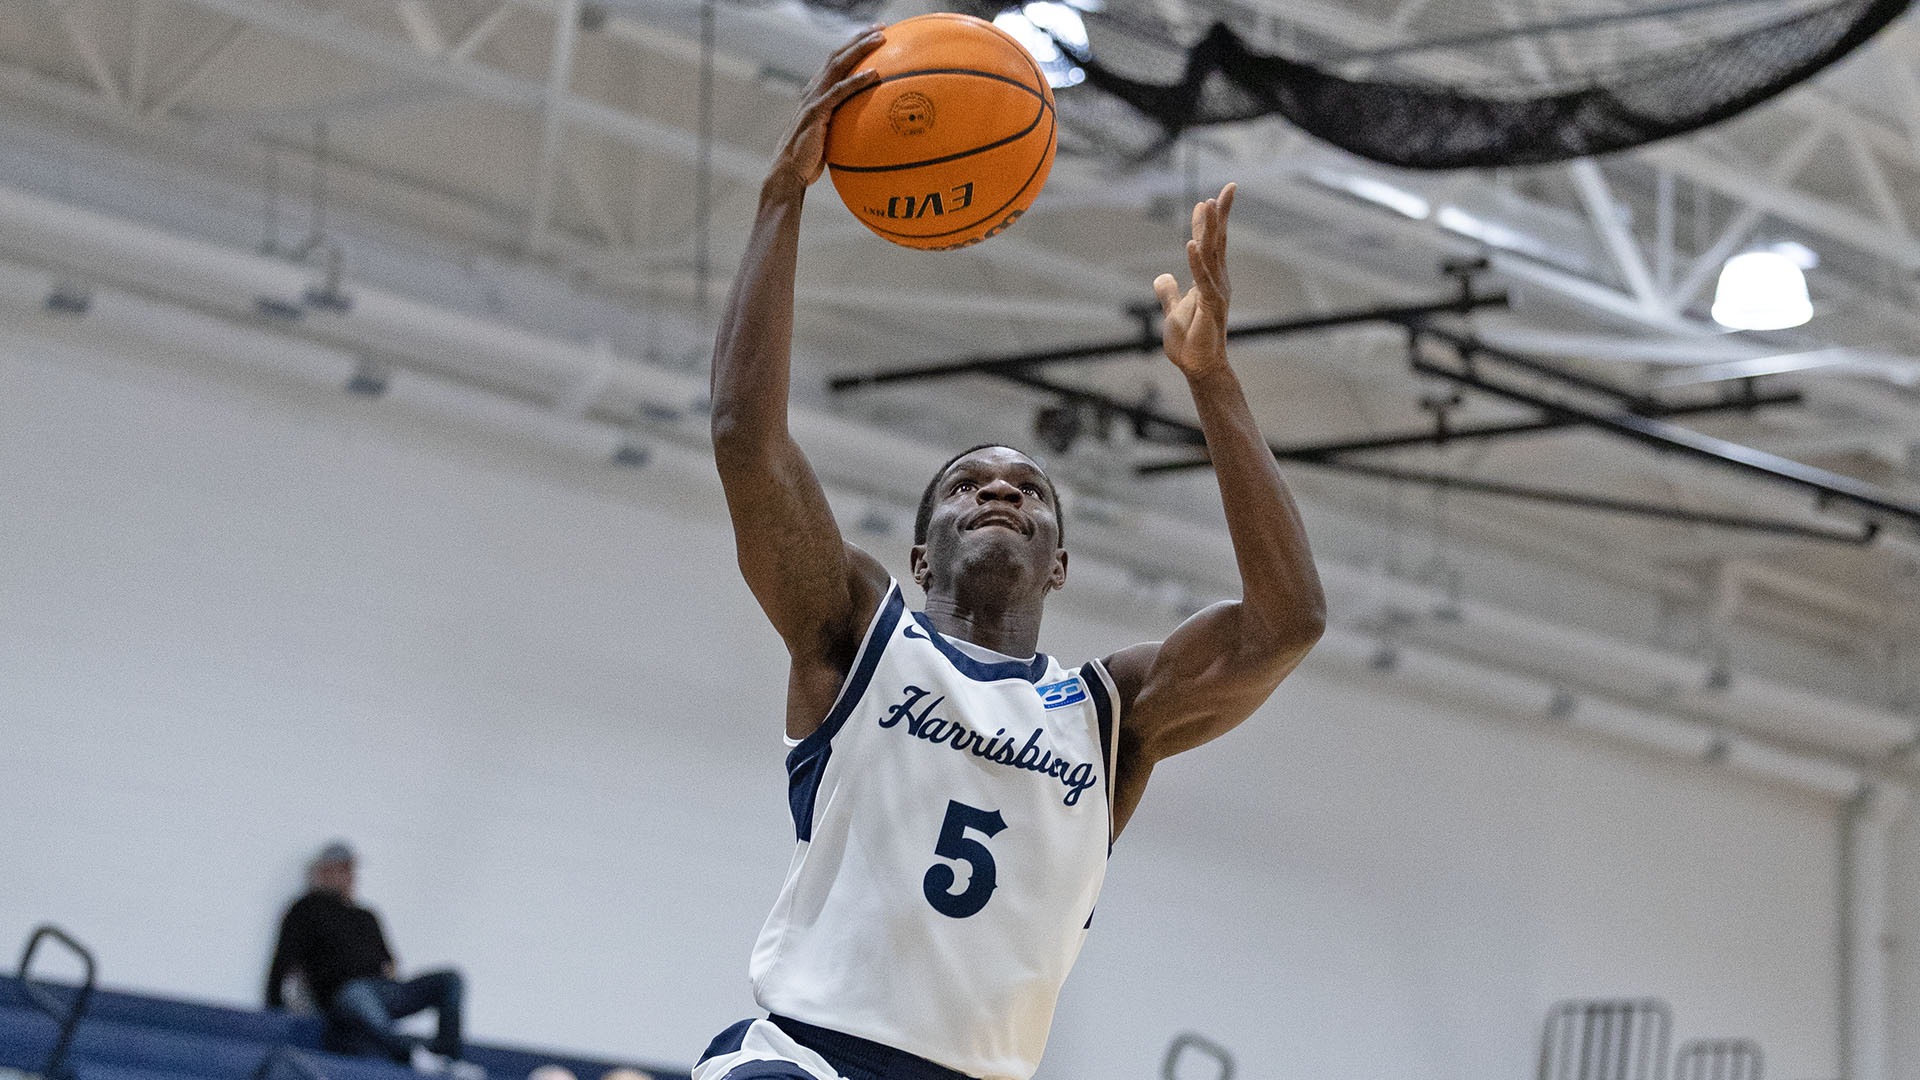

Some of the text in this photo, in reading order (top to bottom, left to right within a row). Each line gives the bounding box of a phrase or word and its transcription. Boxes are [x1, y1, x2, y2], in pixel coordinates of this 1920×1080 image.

[887, 182, 973, 219] EVO
[879, 686, 1096, 806] Harrisburg
[924, 800, 1008, 918] 5
